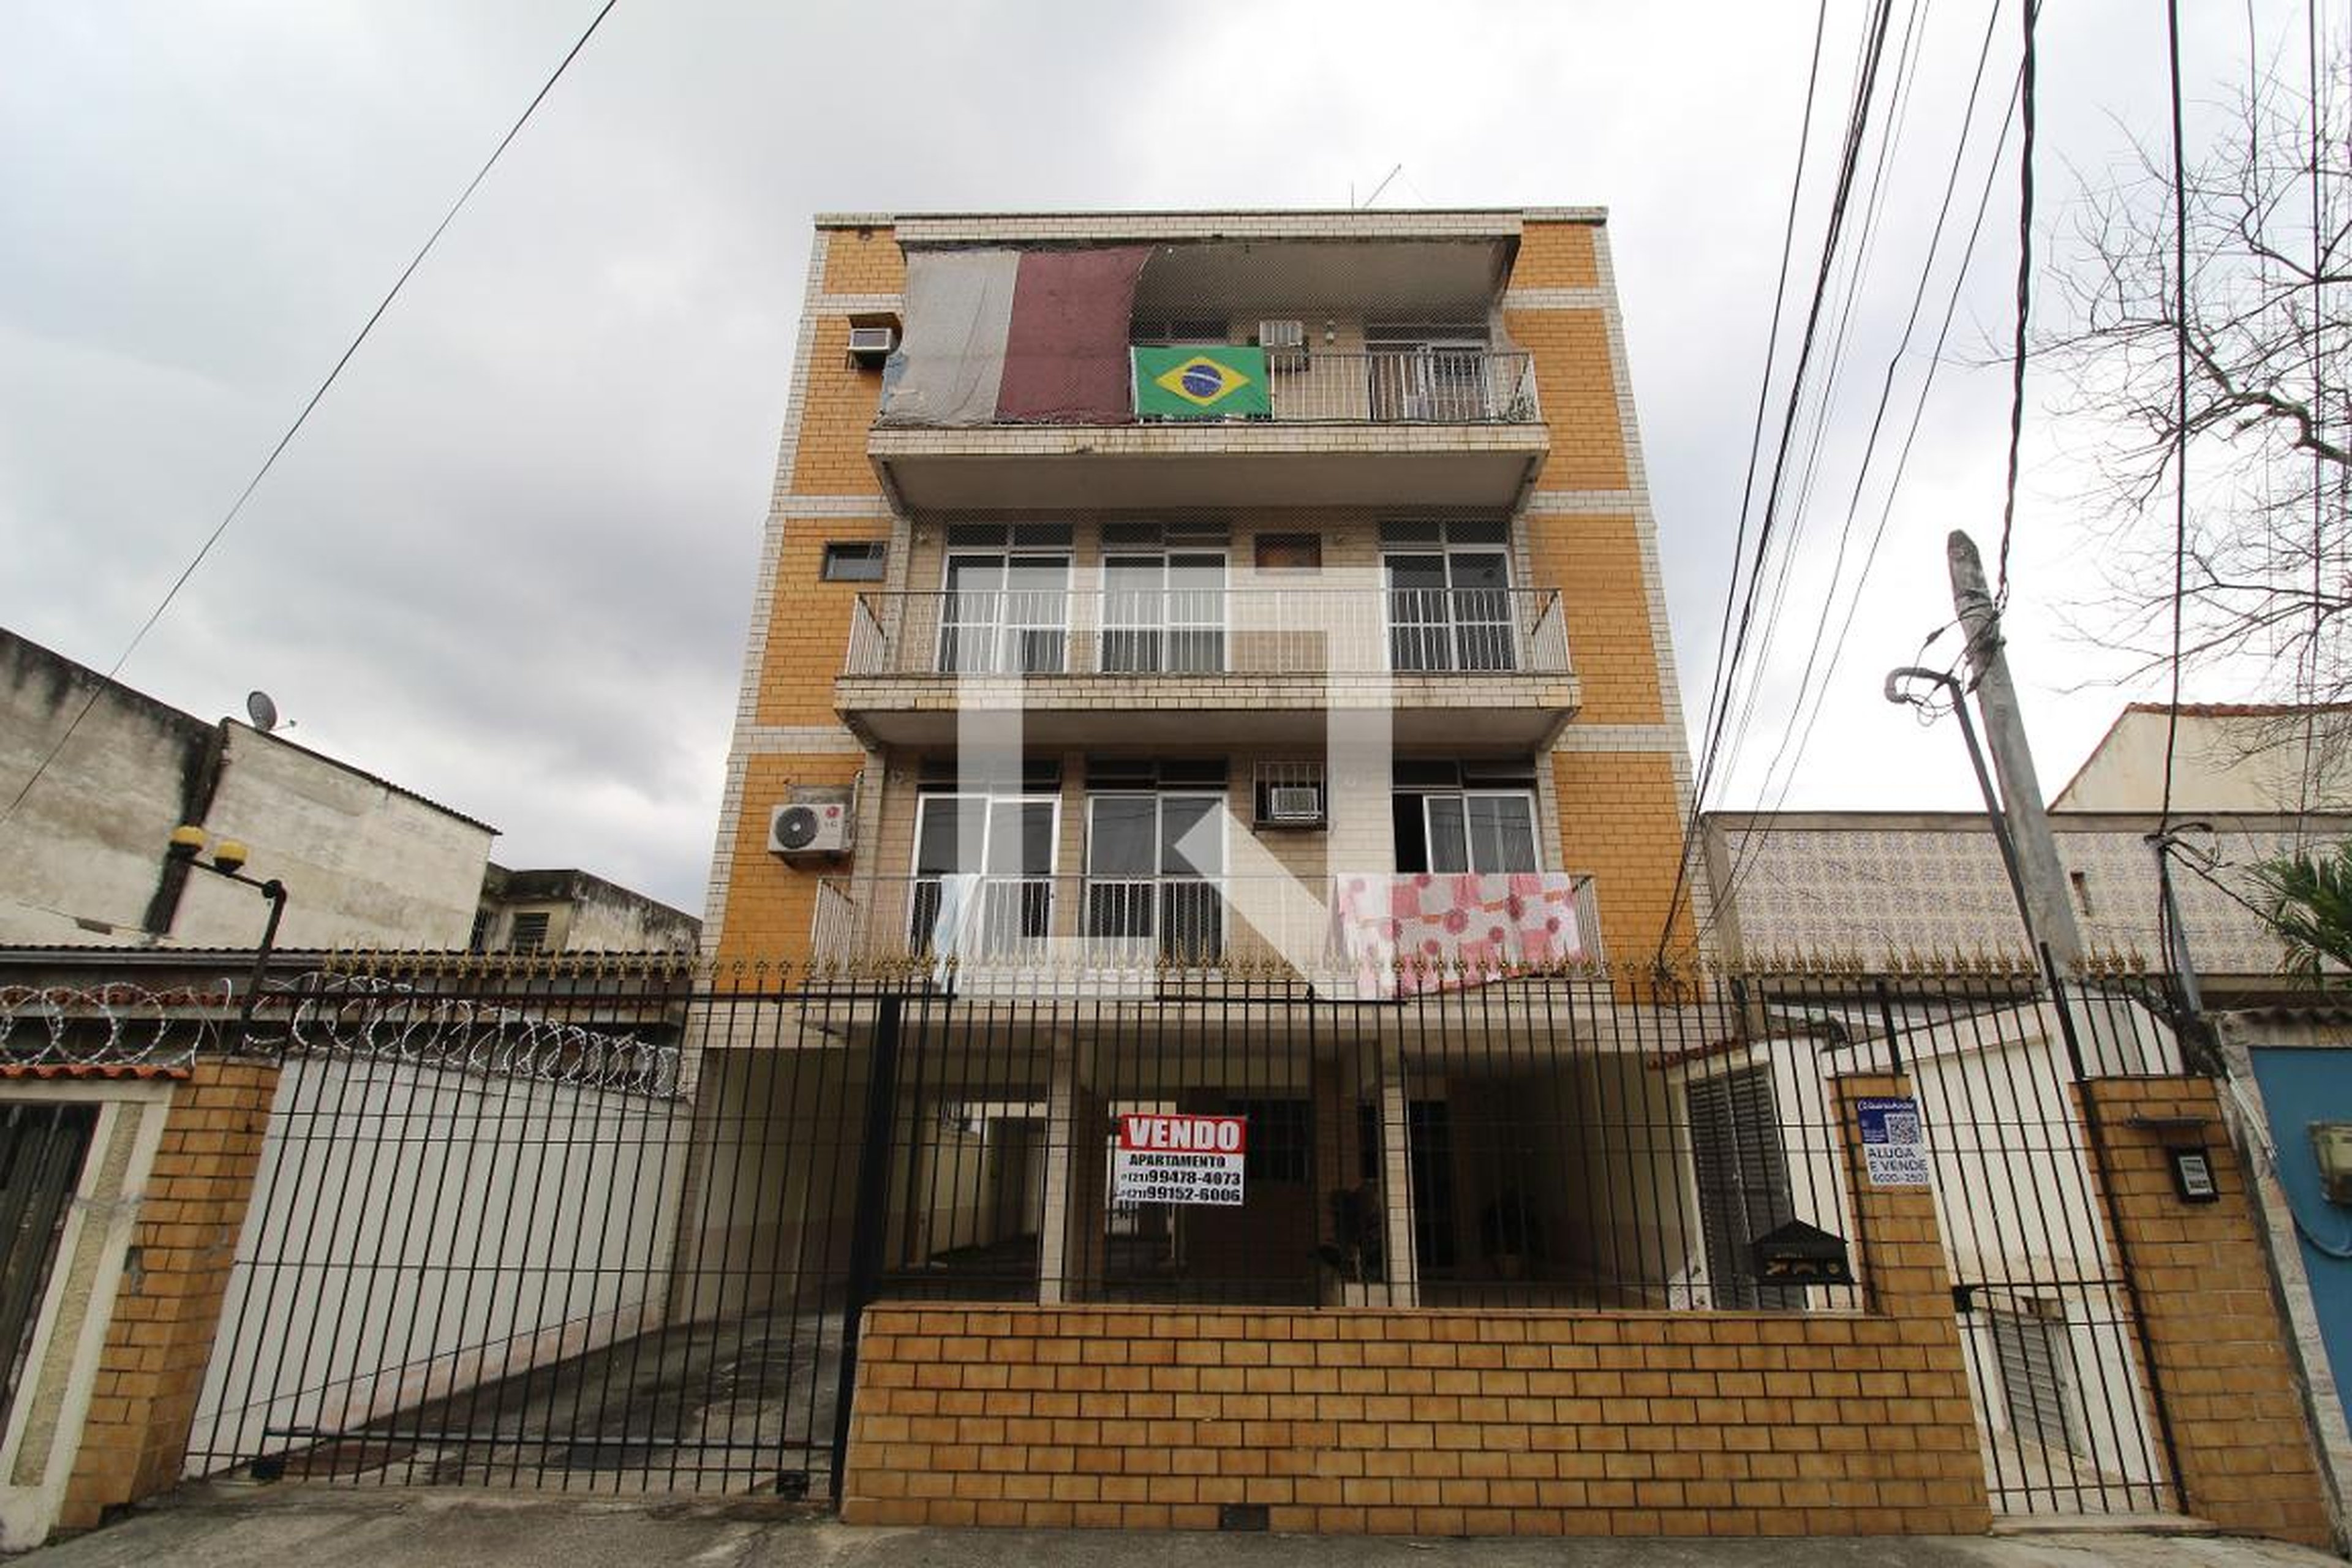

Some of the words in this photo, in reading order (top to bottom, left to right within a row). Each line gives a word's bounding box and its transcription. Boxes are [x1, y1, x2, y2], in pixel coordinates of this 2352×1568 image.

[1128, 1117, 1240, 1151] VENDO
[1869, 1147, 1915, 1158] ALUGA
[1129, 1153, 1226, 1167] APARTAMENTO
[1870, 1161, 1879, 1171] E
[1880, 1159, 1928, 1172] VENDE
